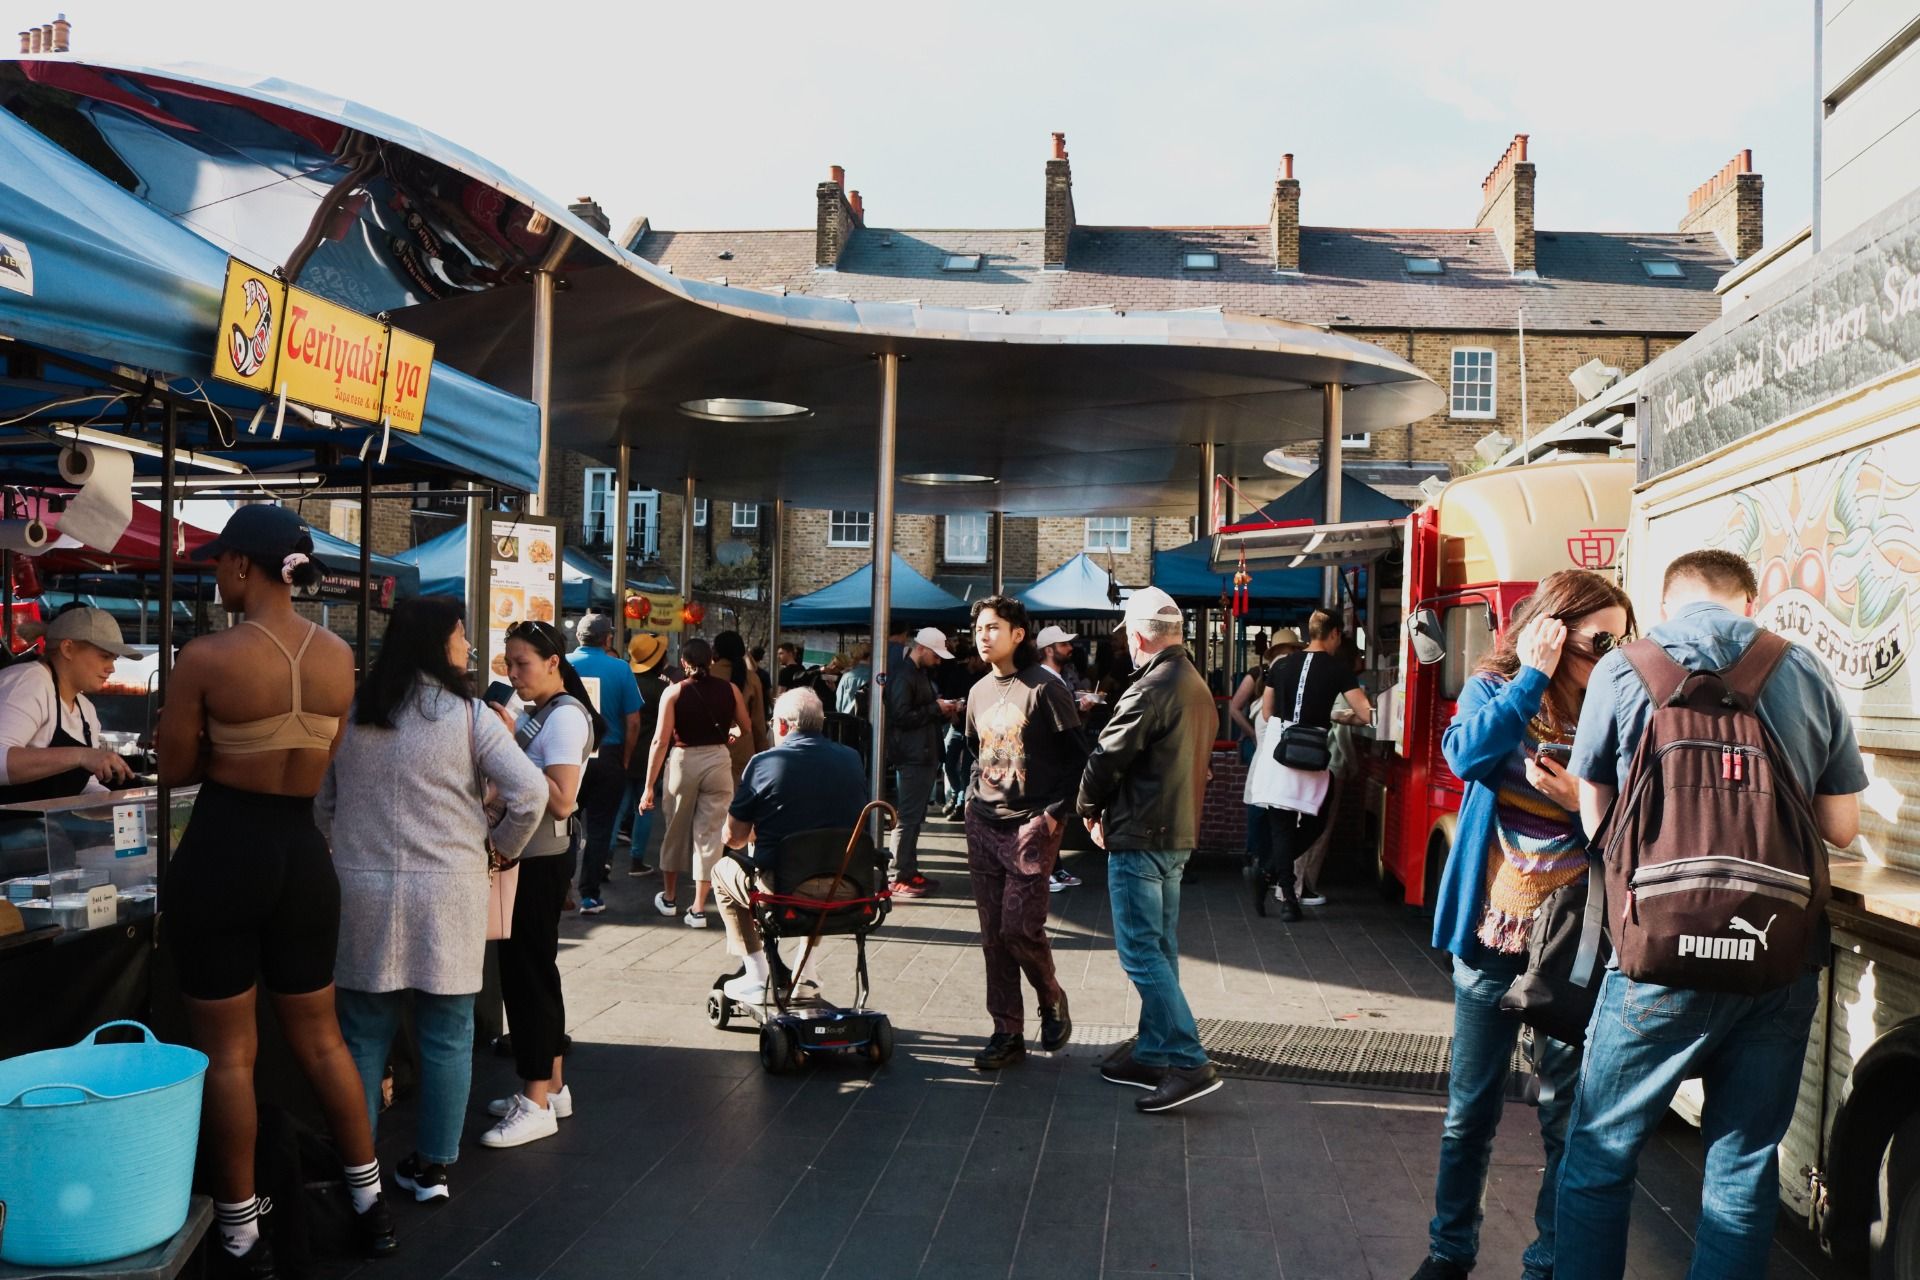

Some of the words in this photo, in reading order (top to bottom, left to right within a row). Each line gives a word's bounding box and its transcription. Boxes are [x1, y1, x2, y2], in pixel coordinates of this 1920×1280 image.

[1663, 389, 1696, 435] Slow
[1703, 339, 1765, 414] Smoked
[1773, 303, 1868, 380] Southern
[334, 387, 364, 406] Japanese
[321, 575, 339, 584] PLANT
[1775, 601, 1814, 636] AND
[1815, 621, 1901, 680] BRISKET
[1677, 934, 1756, 961] PUMA
